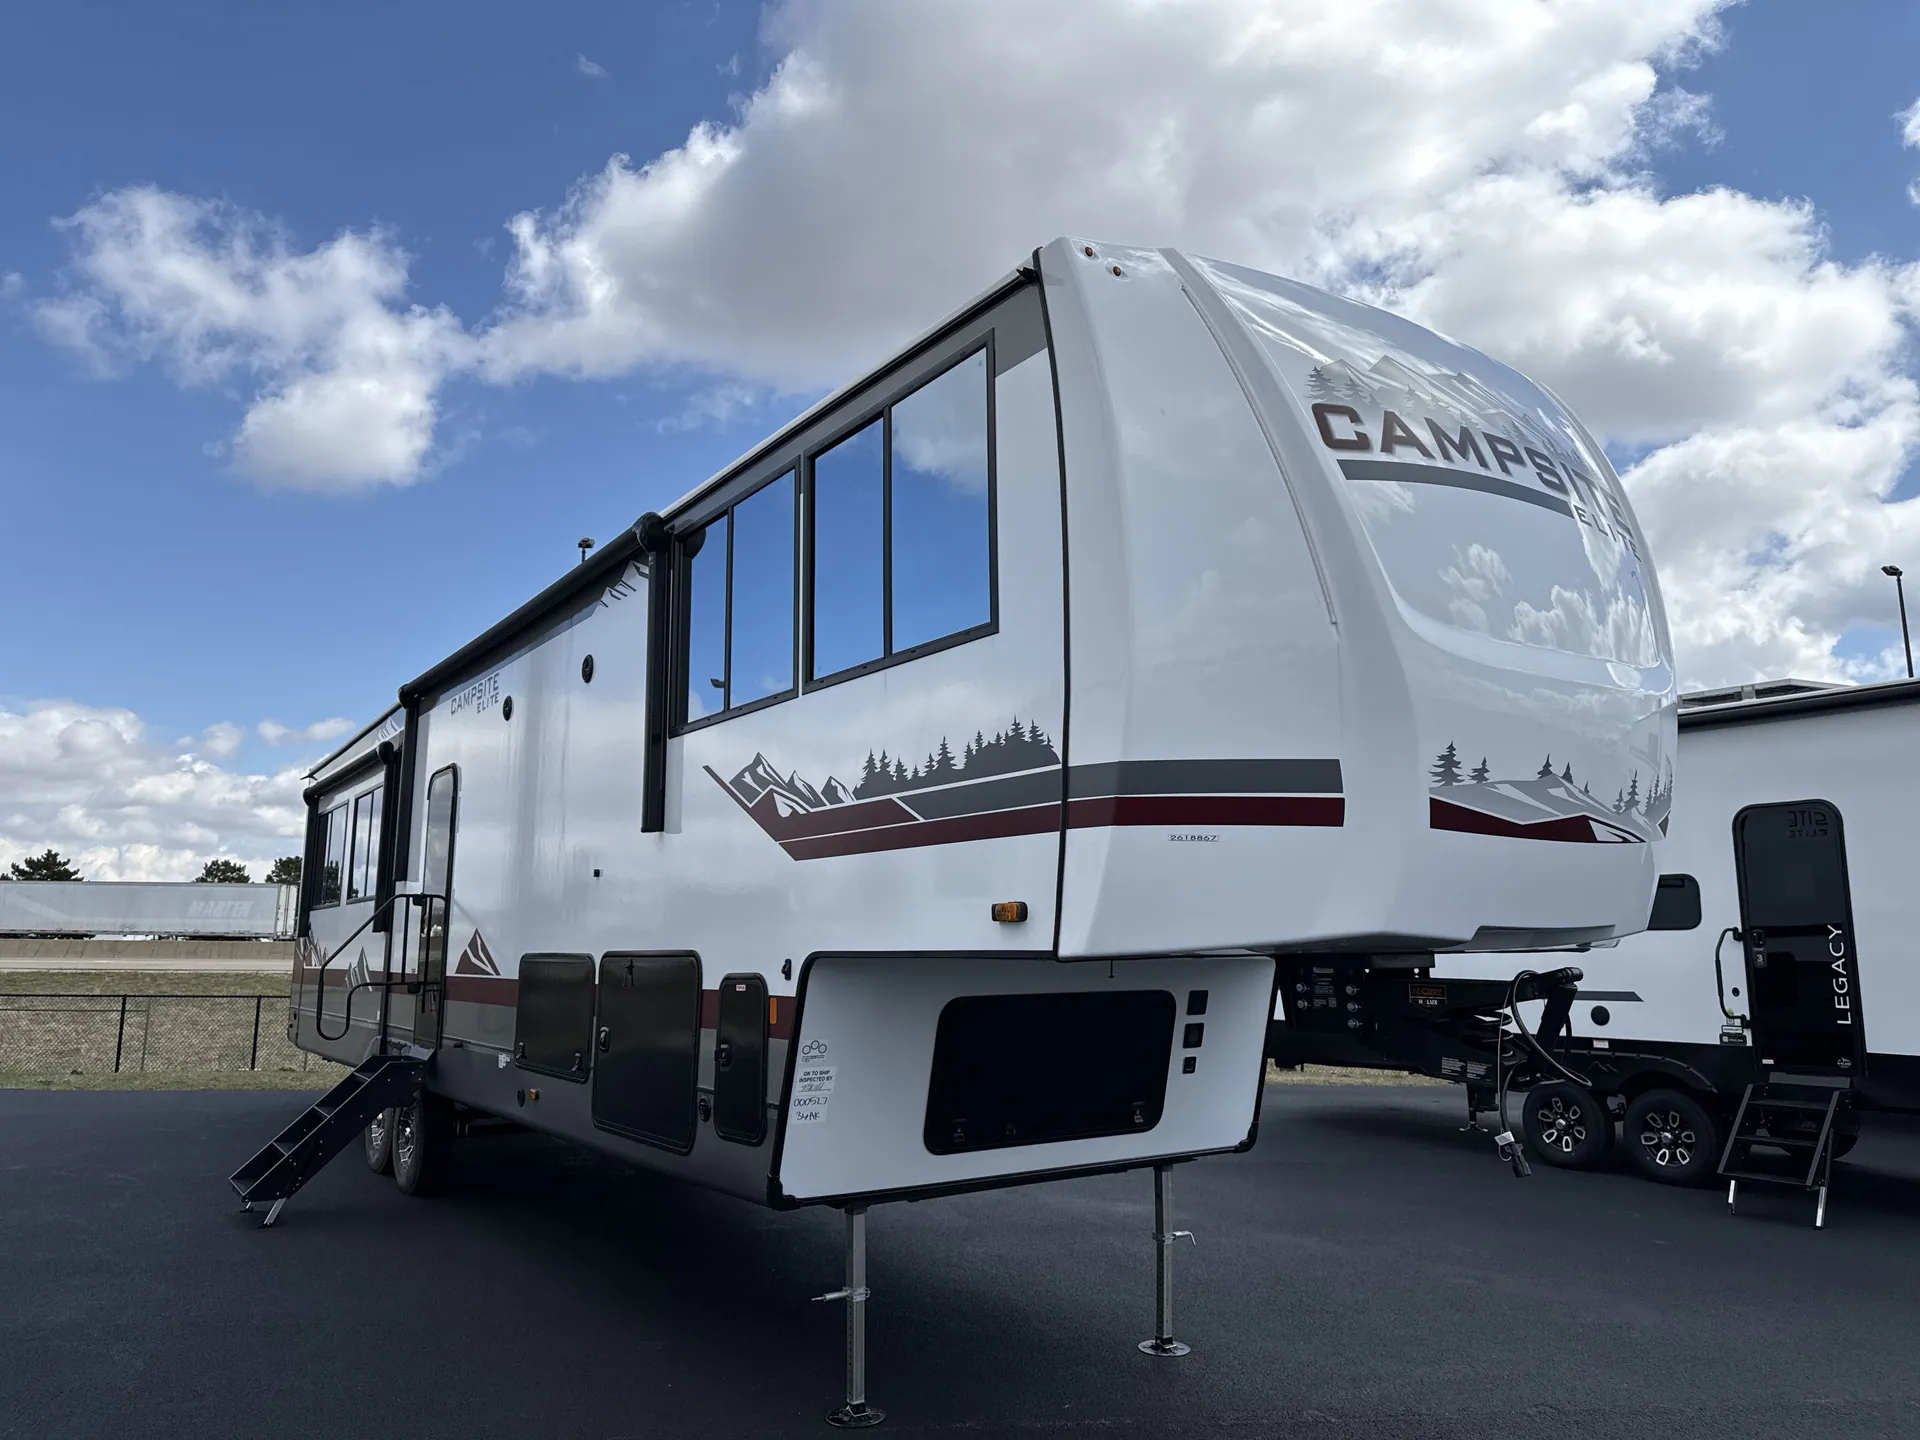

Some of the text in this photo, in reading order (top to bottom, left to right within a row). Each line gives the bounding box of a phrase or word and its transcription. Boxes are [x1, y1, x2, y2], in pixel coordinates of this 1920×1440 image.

[1311, 403, 1635, 540] CAMPSITE
[1573, 504, 1642, 562] ELITE
[450, 672, 500, 716] CAMPSITE
[476, 692, 500, 714] ELITE
[1170, 834, 1217, 842] 2618867
[1827, 924, 1852, 1025] LEGACY
